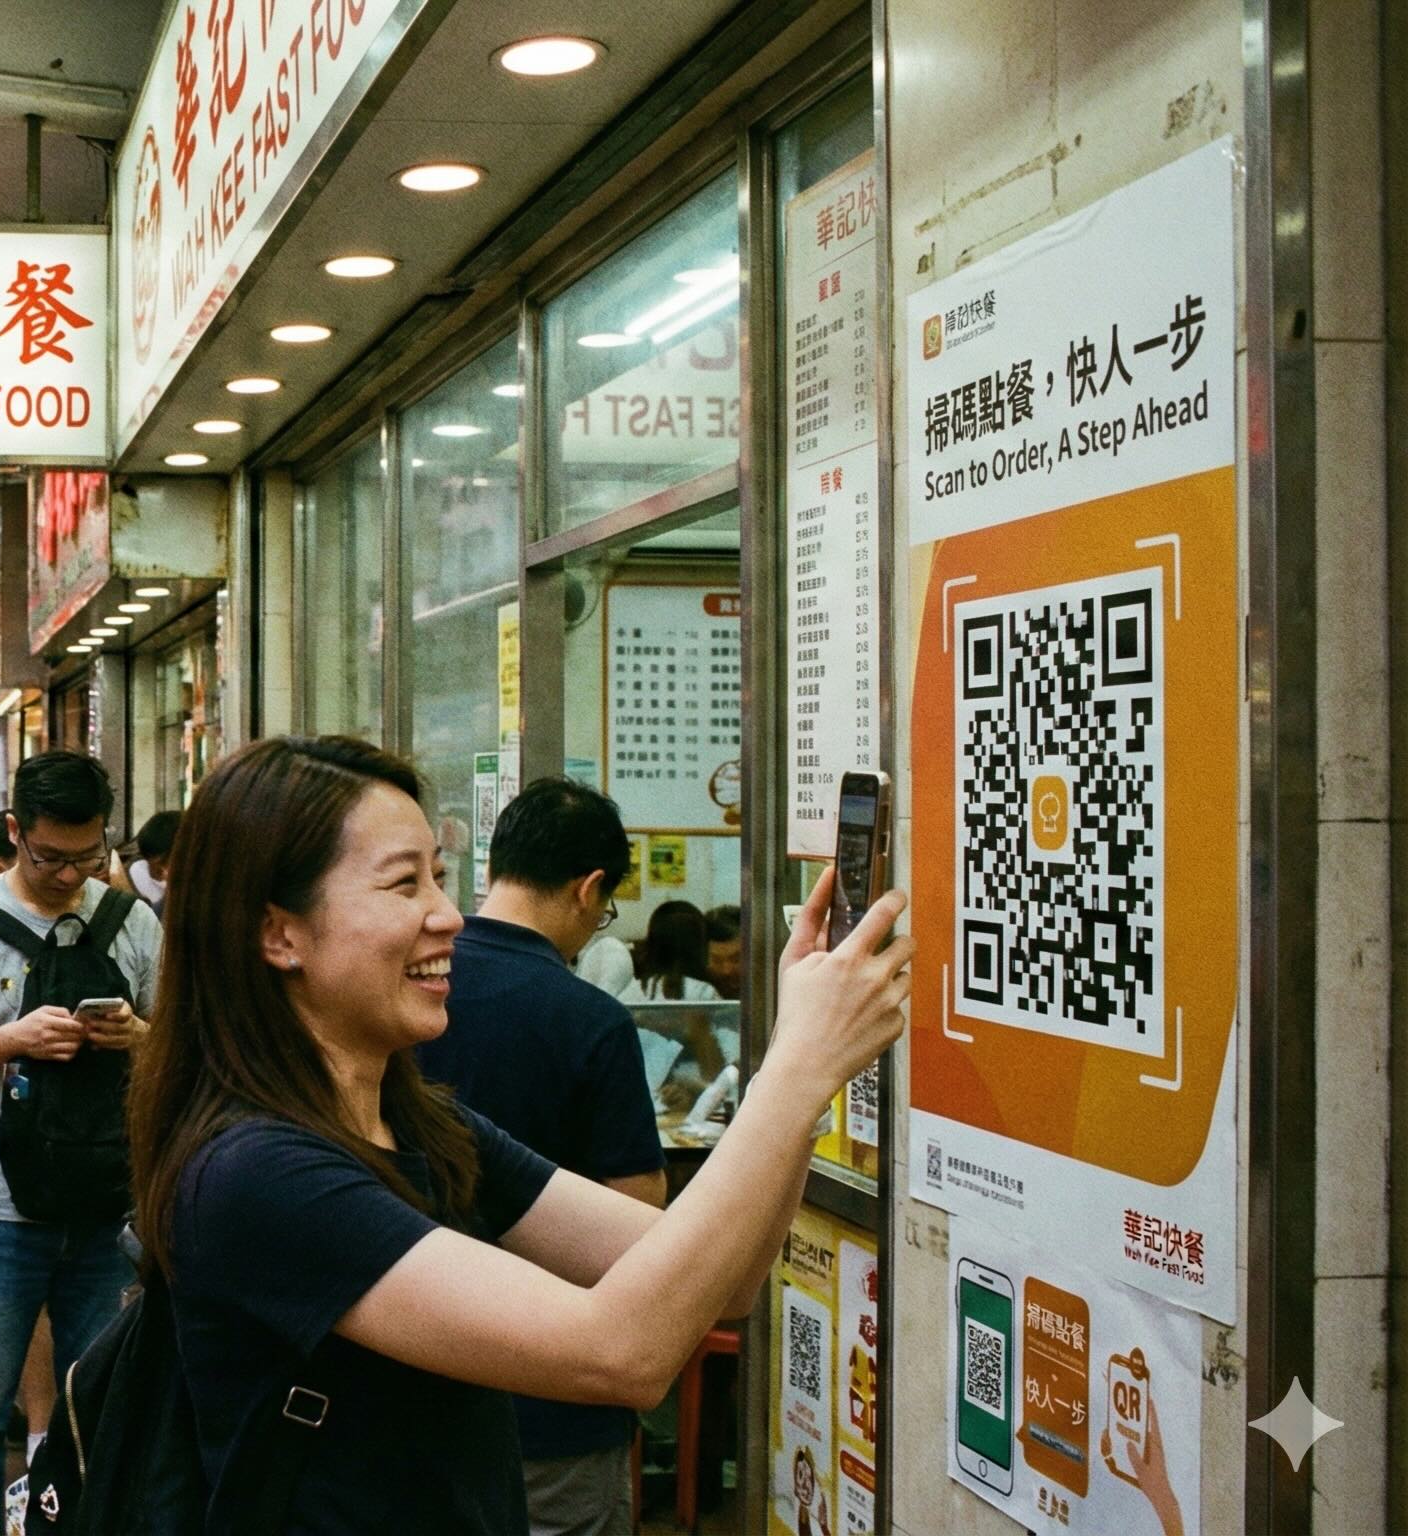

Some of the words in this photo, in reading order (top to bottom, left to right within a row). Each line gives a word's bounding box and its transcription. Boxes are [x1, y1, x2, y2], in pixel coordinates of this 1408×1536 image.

[171, 205, 205, 320] WAH
[210, 132, 245, 258] KEE
[252, 24, 303, 193] FAST
[310, 0, 366, 95] FO
[172, 0, 276, 208] 華記
[925, 460, 964, 501] Scan
[969, 459, 987, 487] to
[992, 439, 1054, 475] Order,
[1058, 427, 1072, 462] A
[1078, 416, 1126, 456] Step
[1132, 379, 1208, 440] Ahead
[1123, 1208, 1204, 1268] 華記快餐
[1113, 1381, 1141, 1423] QR
